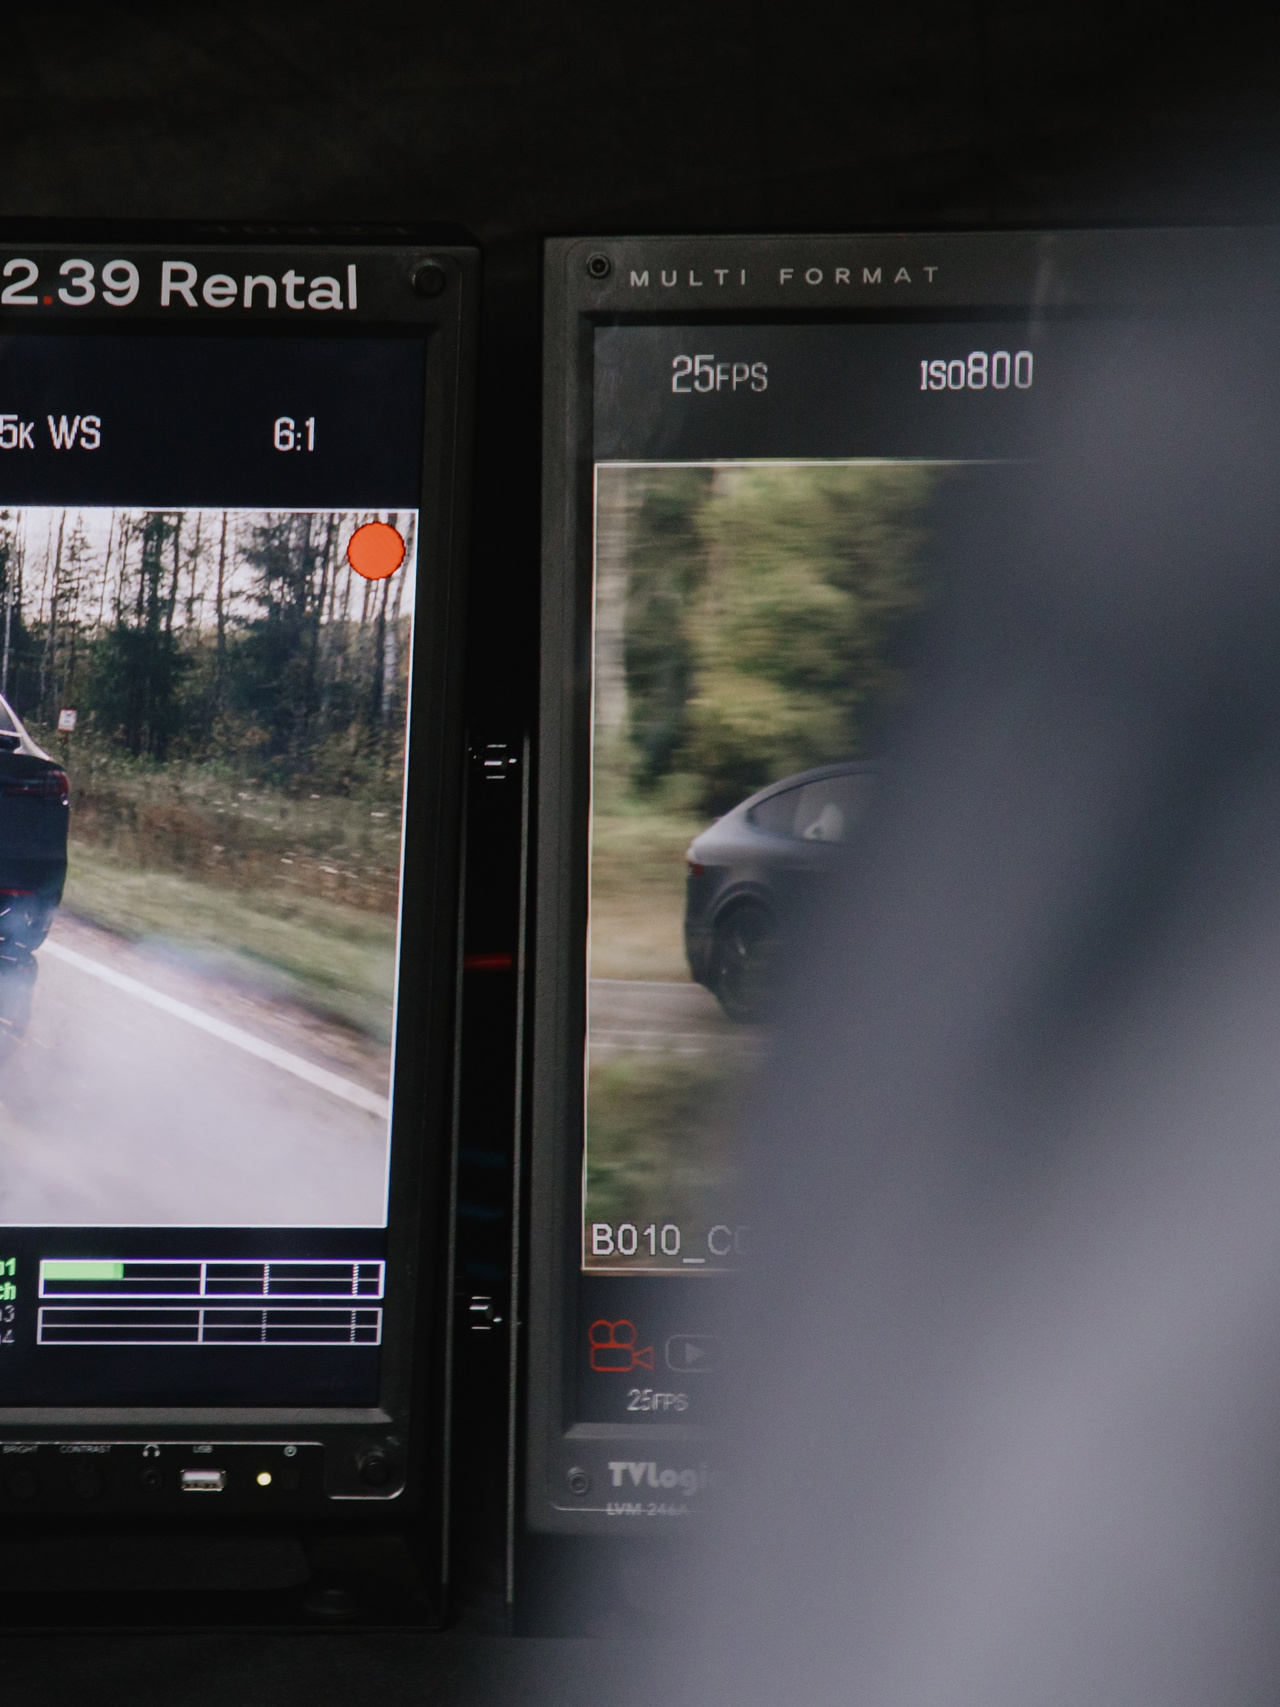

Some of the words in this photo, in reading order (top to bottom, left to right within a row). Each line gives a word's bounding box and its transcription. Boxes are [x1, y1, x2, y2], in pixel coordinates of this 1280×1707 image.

[0, 258, 140, 306] 2.39
[160, 260, 358, 310] Rental
[629, 268, 748, 288] MULTI
[779, 265, 940, 287] FORMAT
[671, 354, 769, 393] 25FPS
[920, 350, 1034, 391] ISO800
[47, 414, 102, 450] WS
[272, 416, 316, 452] 6:1
[192, 1445, 213, 1454] USB
